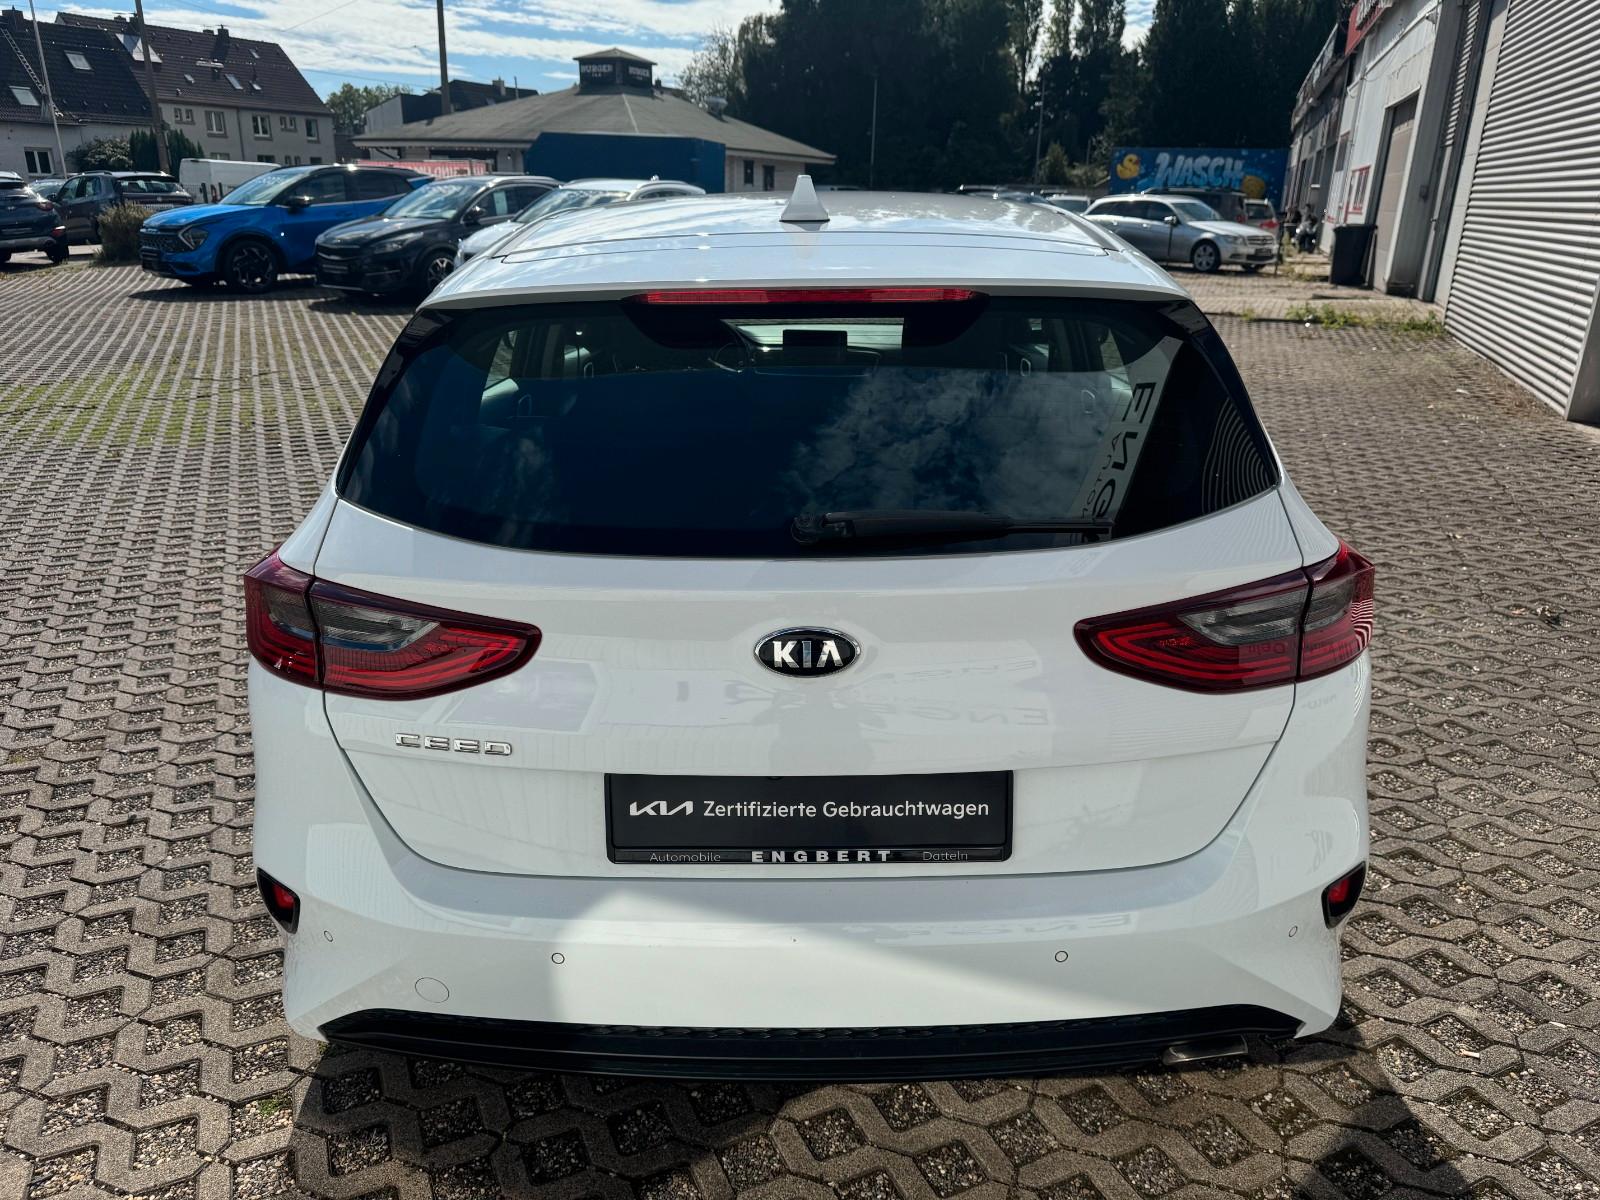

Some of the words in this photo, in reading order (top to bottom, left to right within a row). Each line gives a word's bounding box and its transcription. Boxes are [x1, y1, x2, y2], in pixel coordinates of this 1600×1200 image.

[1155, 152, 1244, 191] WASCH
[773, 640, 844, 668] KIA
[395, 733, 513, 756] CEED
[629, 800, 694, 816] KIA
[703, 800, 817, 817] Zertifizierte
[822, 800, 990, 820] Gebrauchtwagen
[650, 852, 721, 862] Automobile
[751, 850, 891, 862] ENGBERT
[922, 850, 968, 861] Datteln
